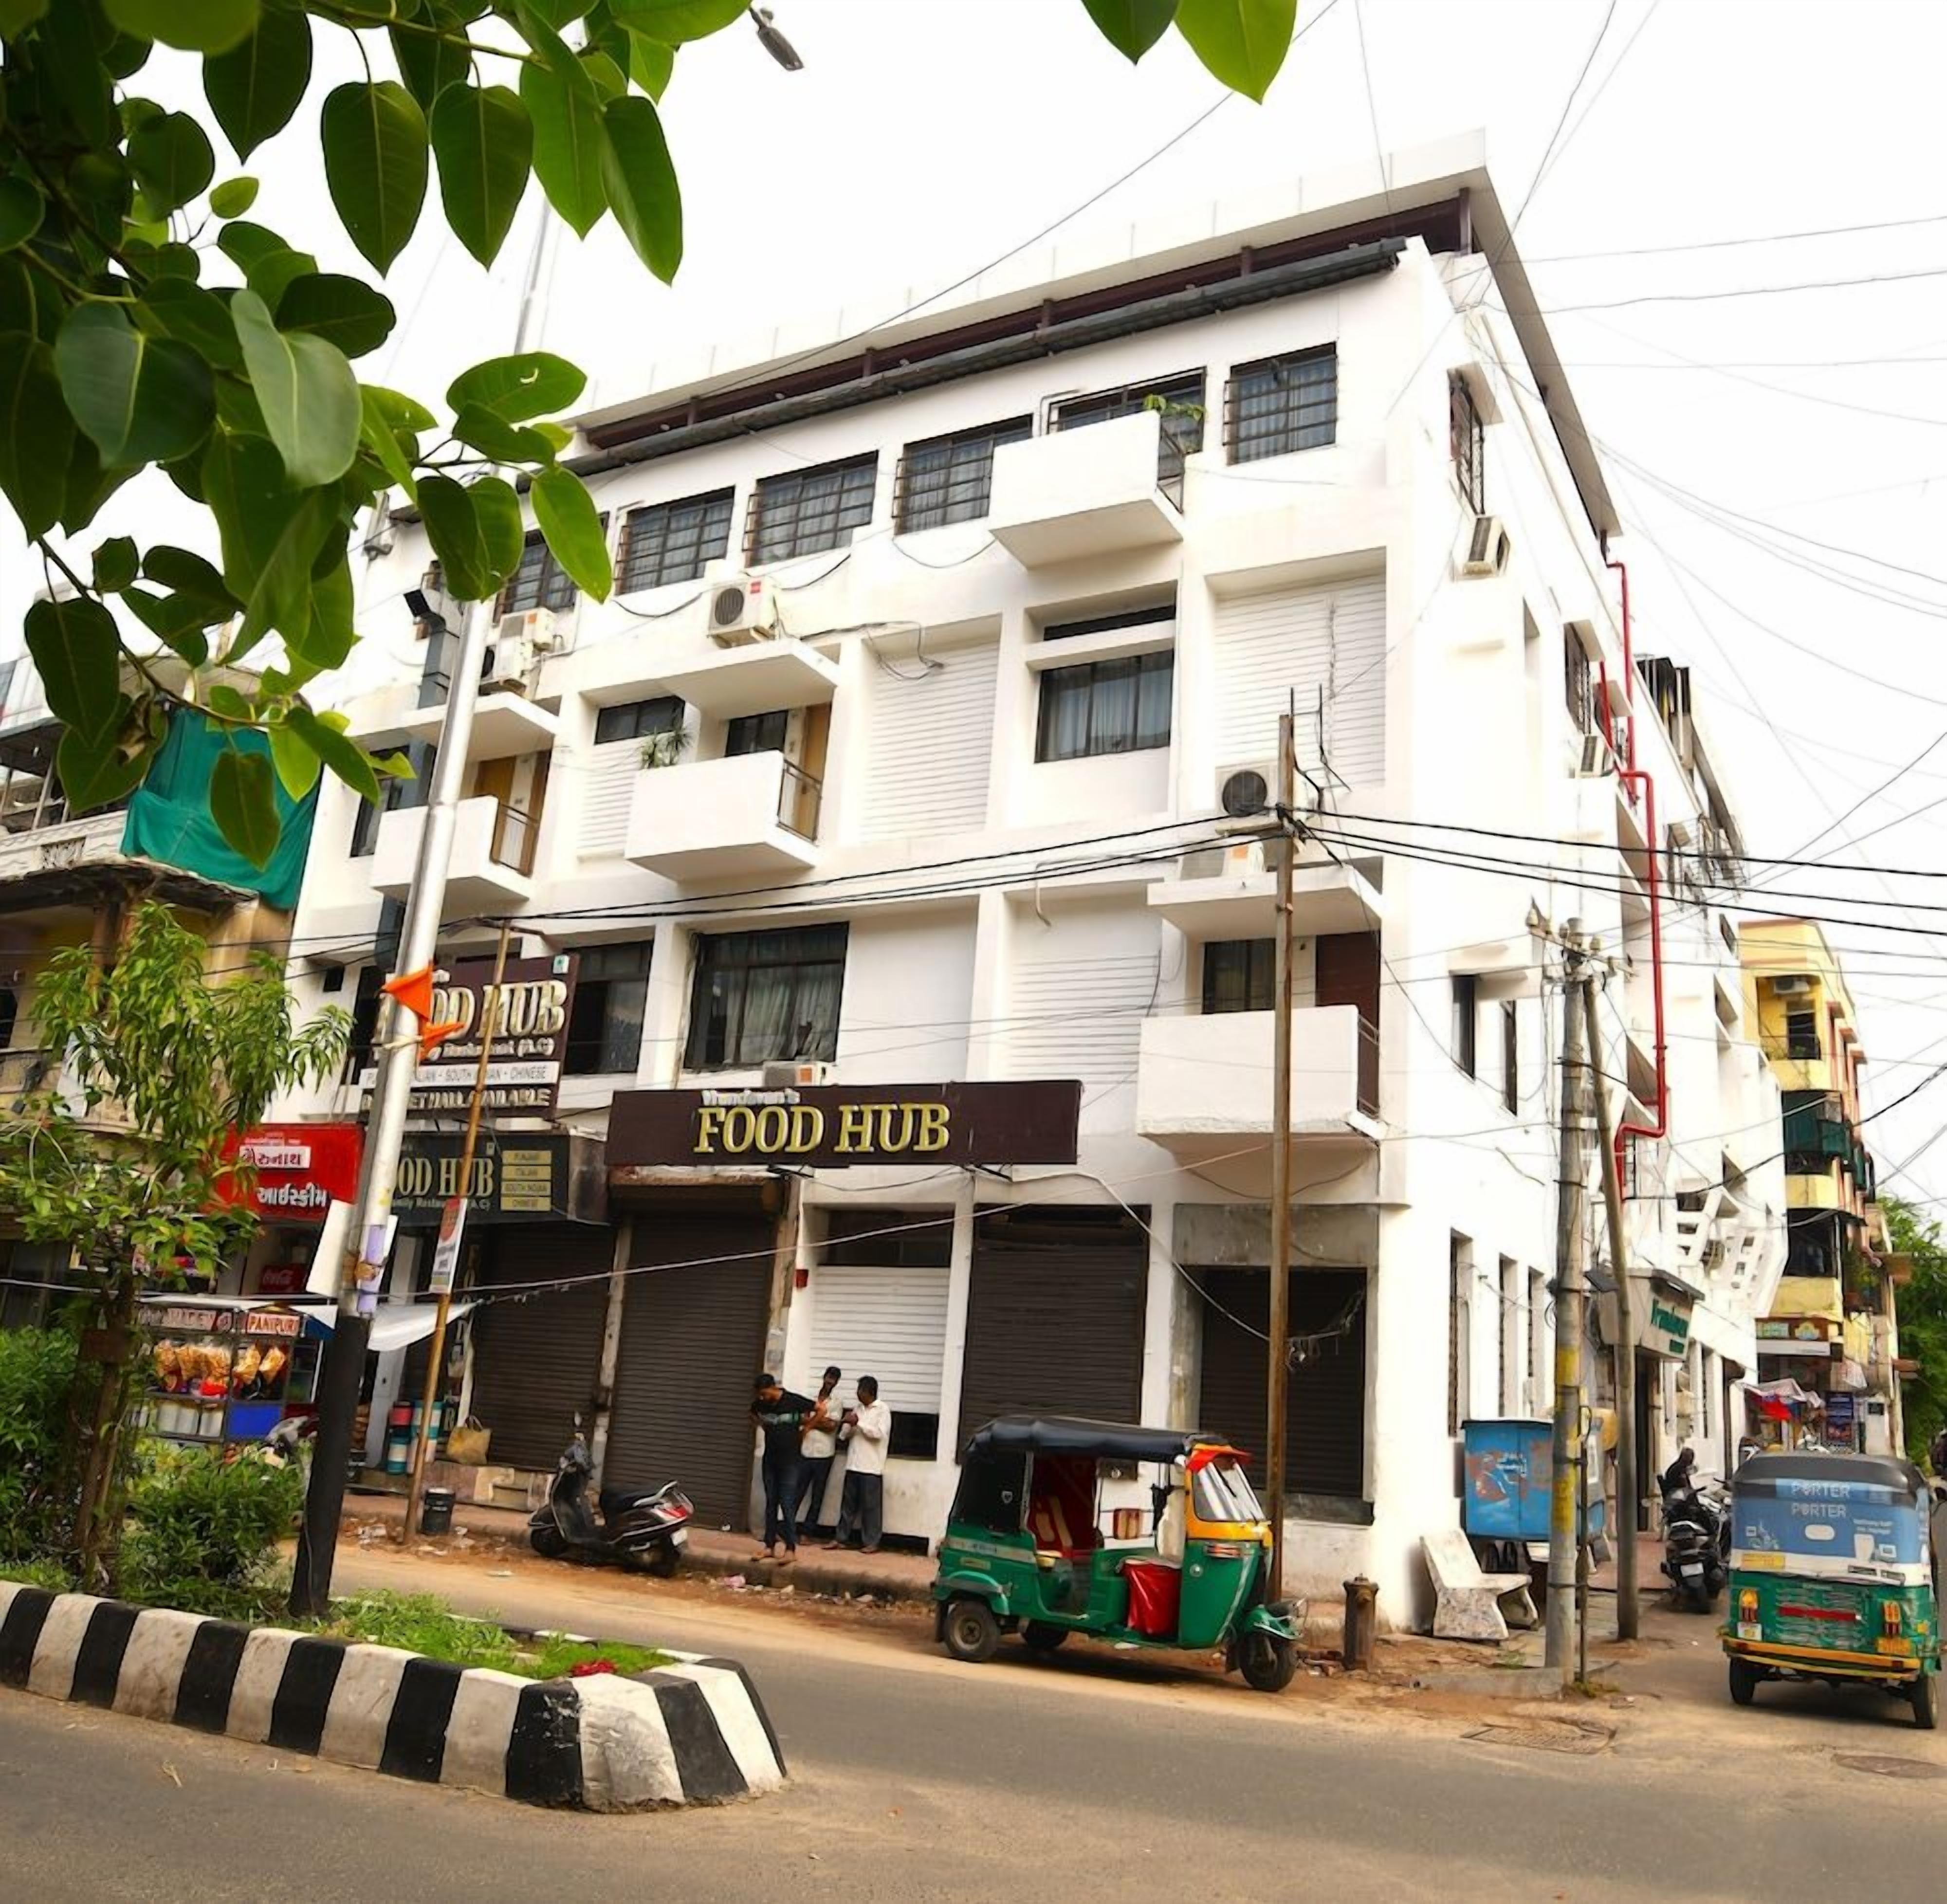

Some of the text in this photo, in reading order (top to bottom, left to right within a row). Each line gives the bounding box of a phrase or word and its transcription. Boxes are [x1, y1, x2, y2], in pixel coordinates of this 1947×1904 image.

[476, 980, 568, 1037] HUB
[693, 1103, 950, 1153] FOOD HUB
[1791, 1481, 1850, 1500] PORTER
[1791, 1502, 1847, 1518] PORTER
